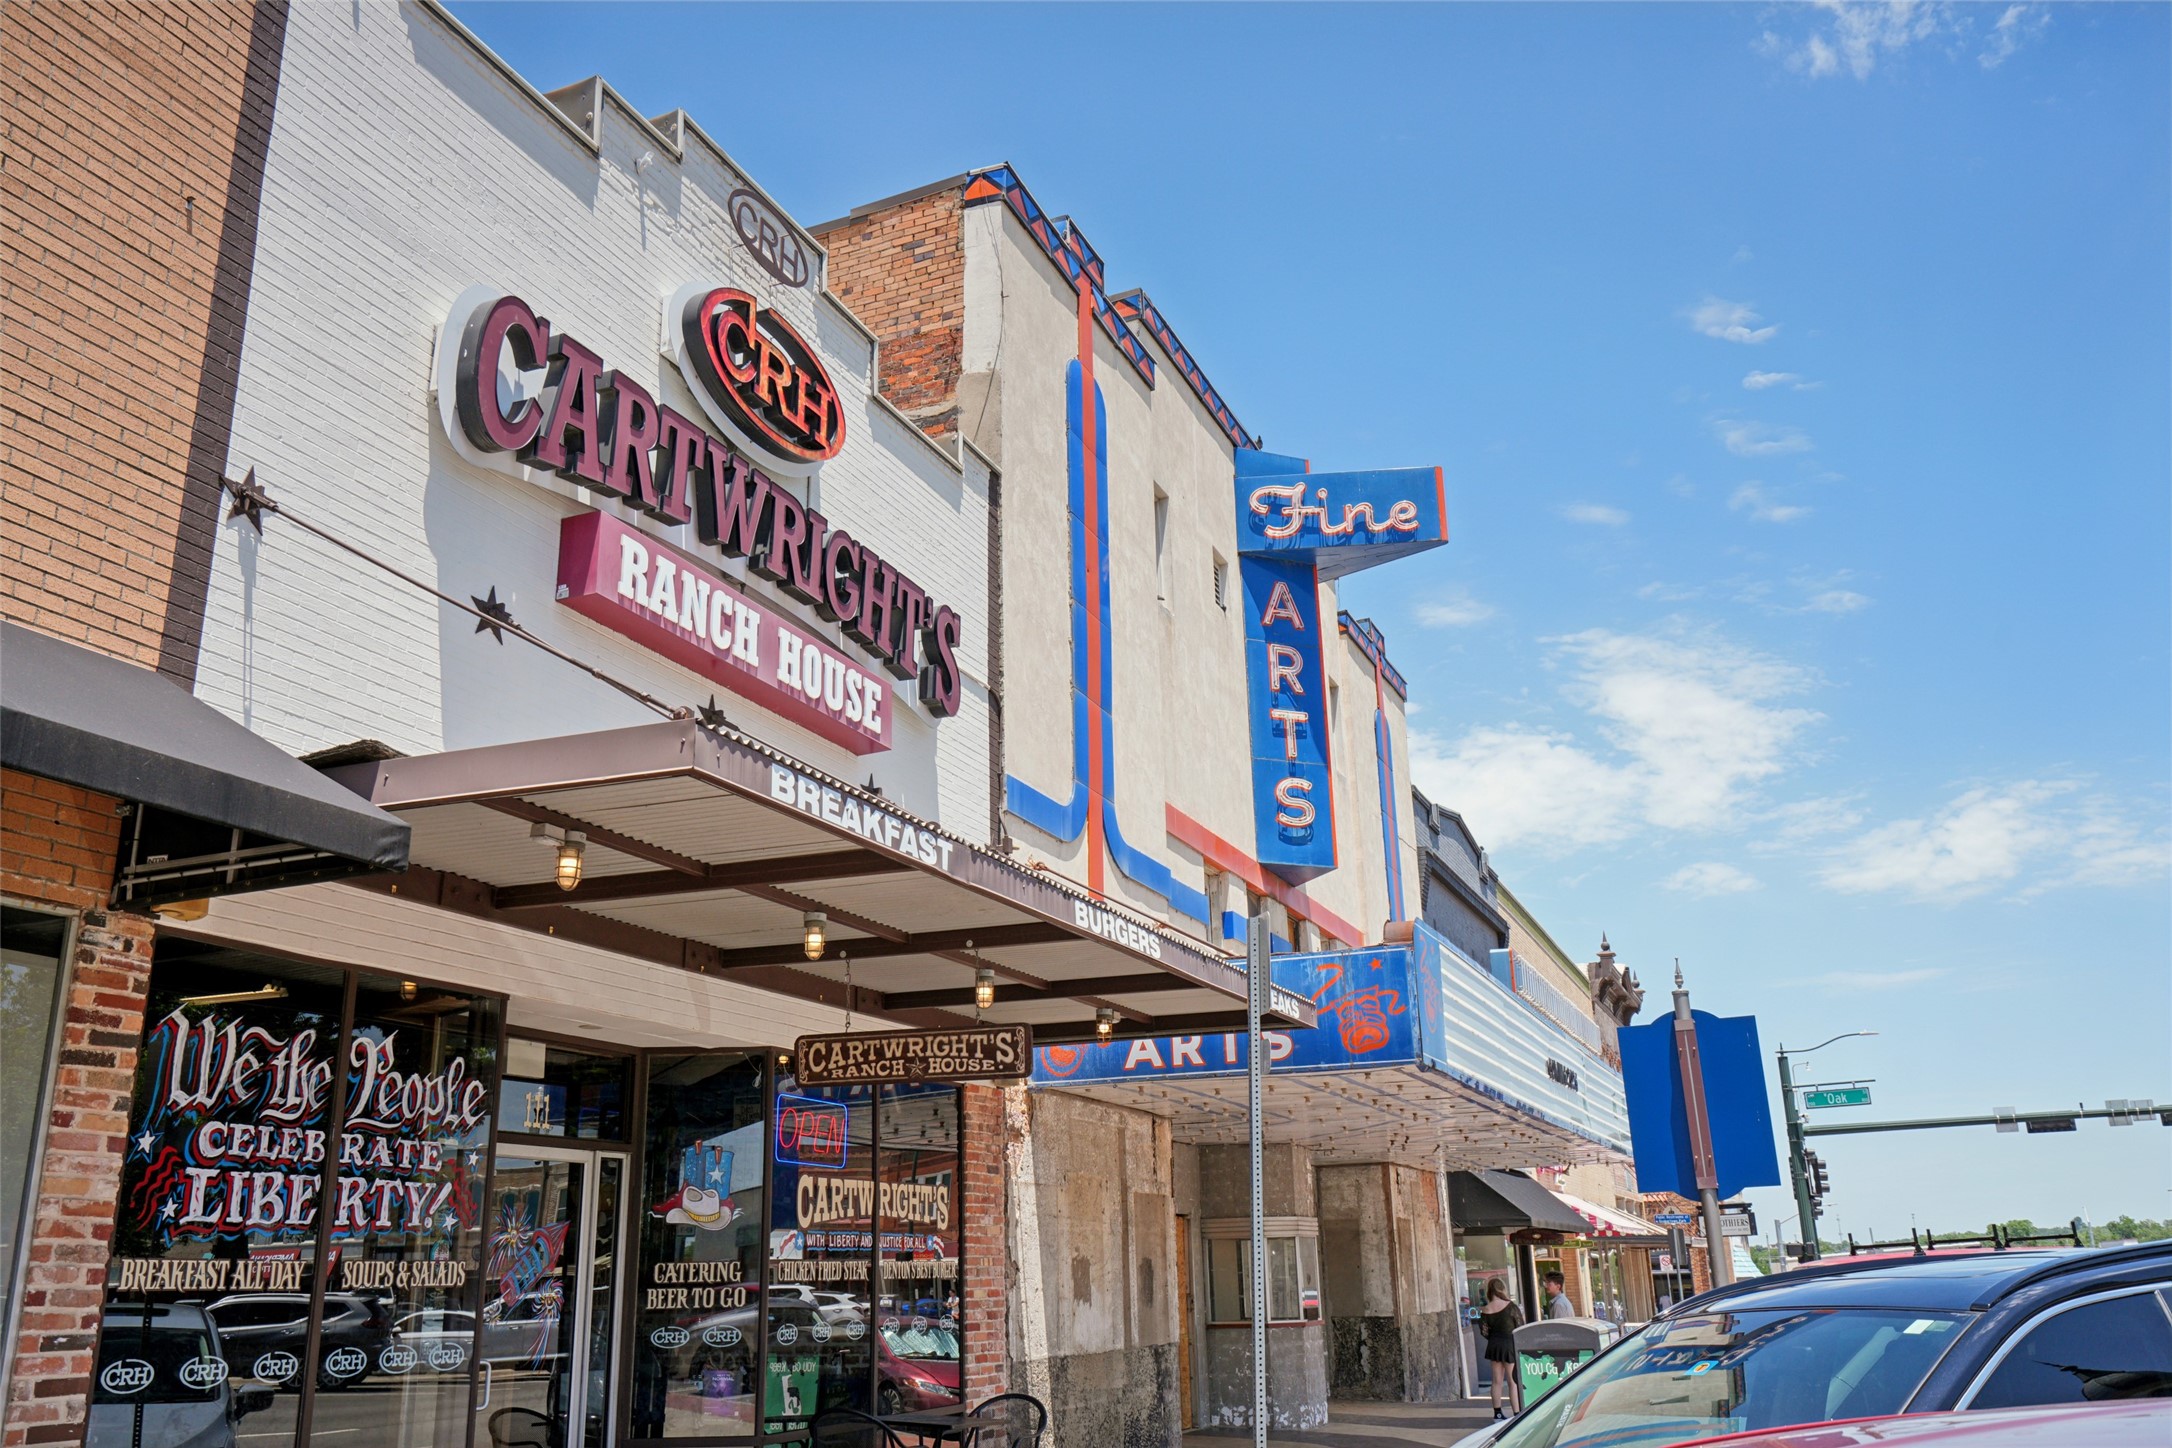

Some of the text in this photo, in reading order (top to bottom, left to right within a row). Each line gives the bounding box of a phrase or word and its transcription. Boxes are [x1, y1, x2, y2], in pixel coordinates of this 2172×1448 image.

[736, 201, 799, 281] CRH
[710, 305, 834, 450] CRH
[460, 295, 962, 718] CARTWRIGHT'S
[1249, 481, 1419, 539] Fine
[617, 534, 883, 734] RANCH HOUSE
[1262, 581, 1317, 829] ARTS
[771, 763, 954, 872] BREAKFAST
[1074, 899, 1161, 960] BURGERS
[1270, 988, 1300, 1020] EAKS
[157, 1002, 489, 1132] We the People
[808, 1032, 1015, 1074] CARTWRIGHT'S
[831, 1057, 995, 1079] RANCH HOUSE
[523, 1091, 550, 1129] 111
[1827, 1092, 1848, 1104] Oak
[199, 1121, 443, 1172] CELEBRATE
[779, 1107, 845, 1154] OPEN
[180, 1168, 454, 1229] LIBERTY!
[797, 1174, 950, 1231] CARTWRIGHT'S
[806, 1233, 826, 1247] WITH
[828, 1233, 860, 1248] LIBERTY
[861, 1233, 873, 1248] AND
[904, 1236, 914, 1249] FOR
[914, 1236, 926, 1249] ALL
[117, 1257, 308, 1293] BREAKFAST ALL DAY
[341, 1260, 467, 1290] SOUPS & SALADS
[653, 1261, 743, 1284] CATERING
[778, 1260, 958, 1282] CHICKEN FRIED STEAK DENTON'S BEST BURGER
[645, 1286, 746, 1310] BEER TO GO
[1524, 1362, 1543, 1375] YOU
[1546, 1362, 1565, 1375] Ca
